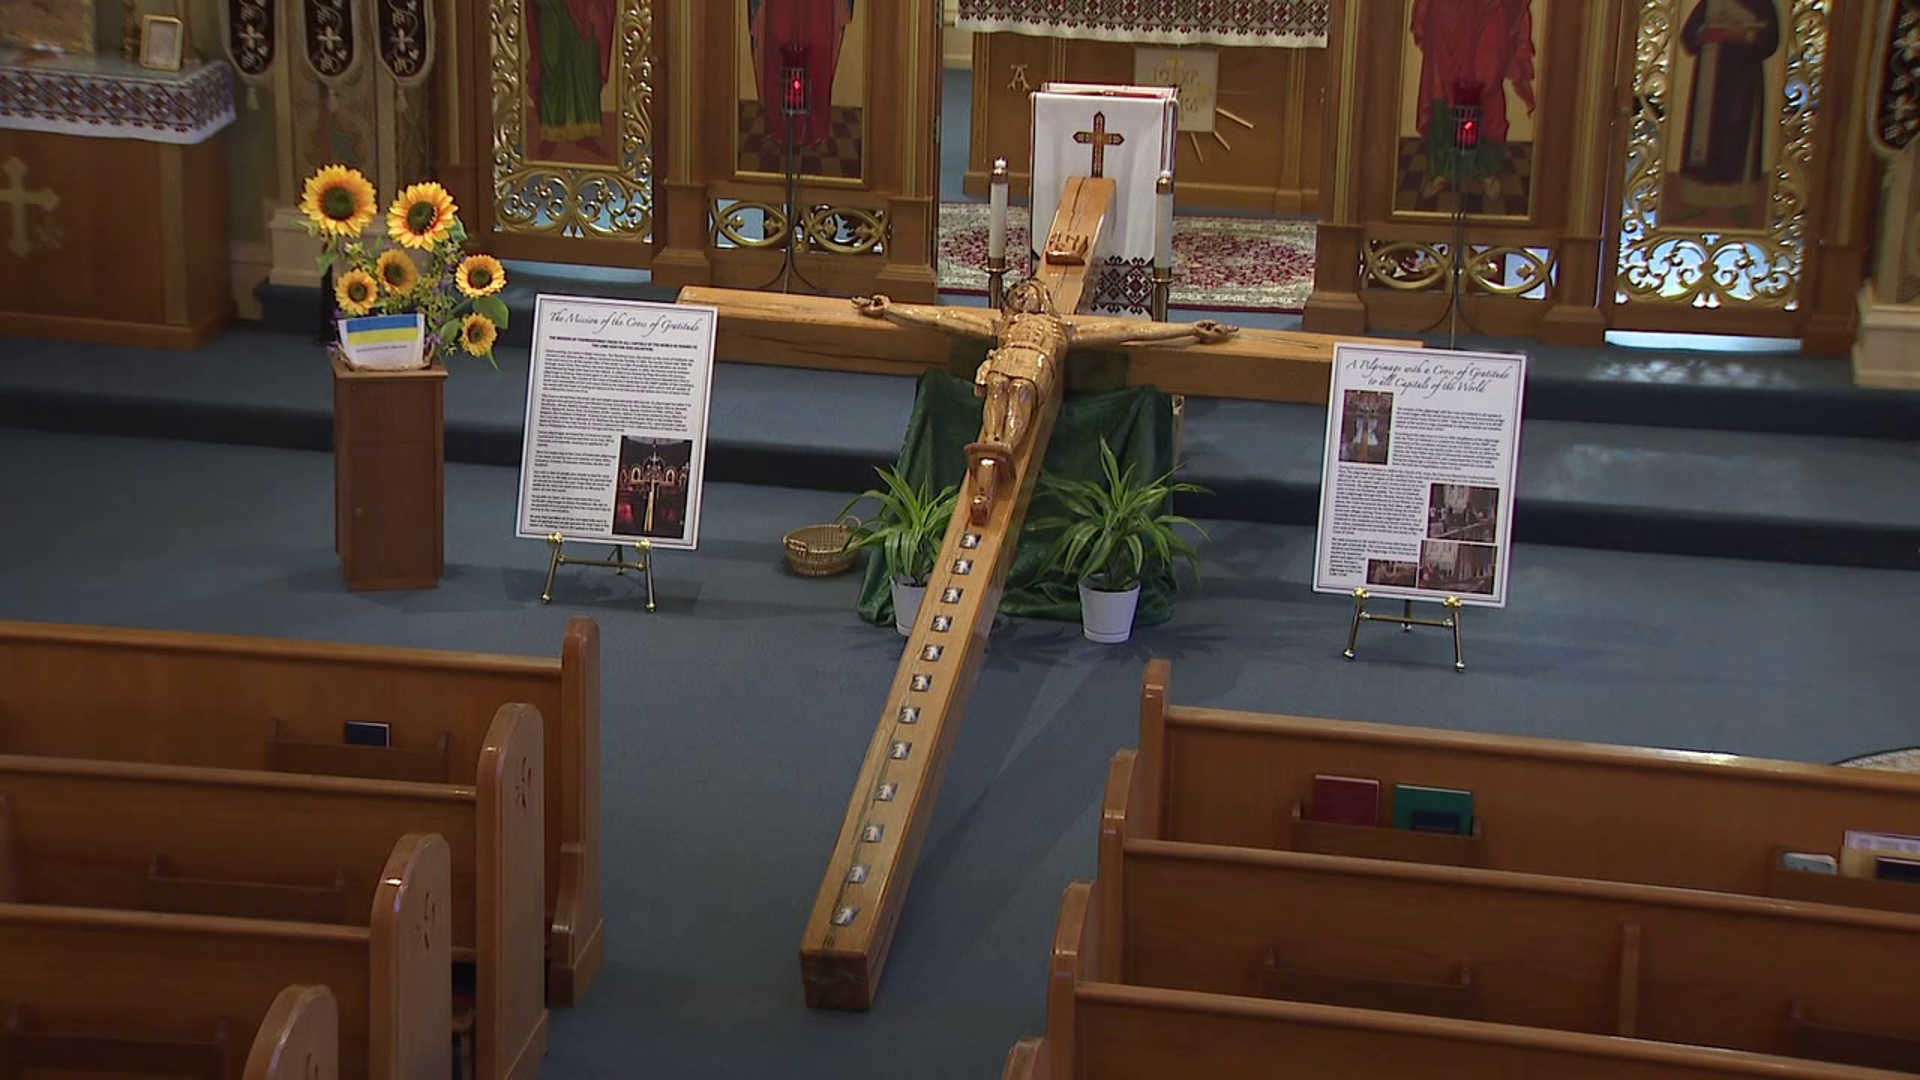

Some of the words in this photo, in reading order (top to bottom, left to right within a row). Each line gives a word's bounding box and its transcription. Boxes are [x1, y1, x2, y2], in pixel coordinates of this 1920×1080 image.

[550, 308, 567, 322] The
[565, 313, 598, 324] Mission
[592, 312, 617, 335] of
[611, 312, 627, 326] the
[626, 317, 647, 327] Cross
[641, 315, 666, 338] of
[661, 318, 702, 333] Gratitude
[1345, 359, 1358, 370] A
[1359, 357, 1402, 378] Pilgrimage
[1403, 360, 1429, 373] with
[1433, 365, 1454, 376] Cross
[1469, 365, 1513, 381] Gratitude
[1367, 377, 1377, 386] to
[1379, 374, 1397, 387] all
[1394, 376, 1432, 396] Capitals
[1422, 375, 1448, 400] of
[1441, 376, 1457, 391] the
[1457, 379, 1492, 393] World
